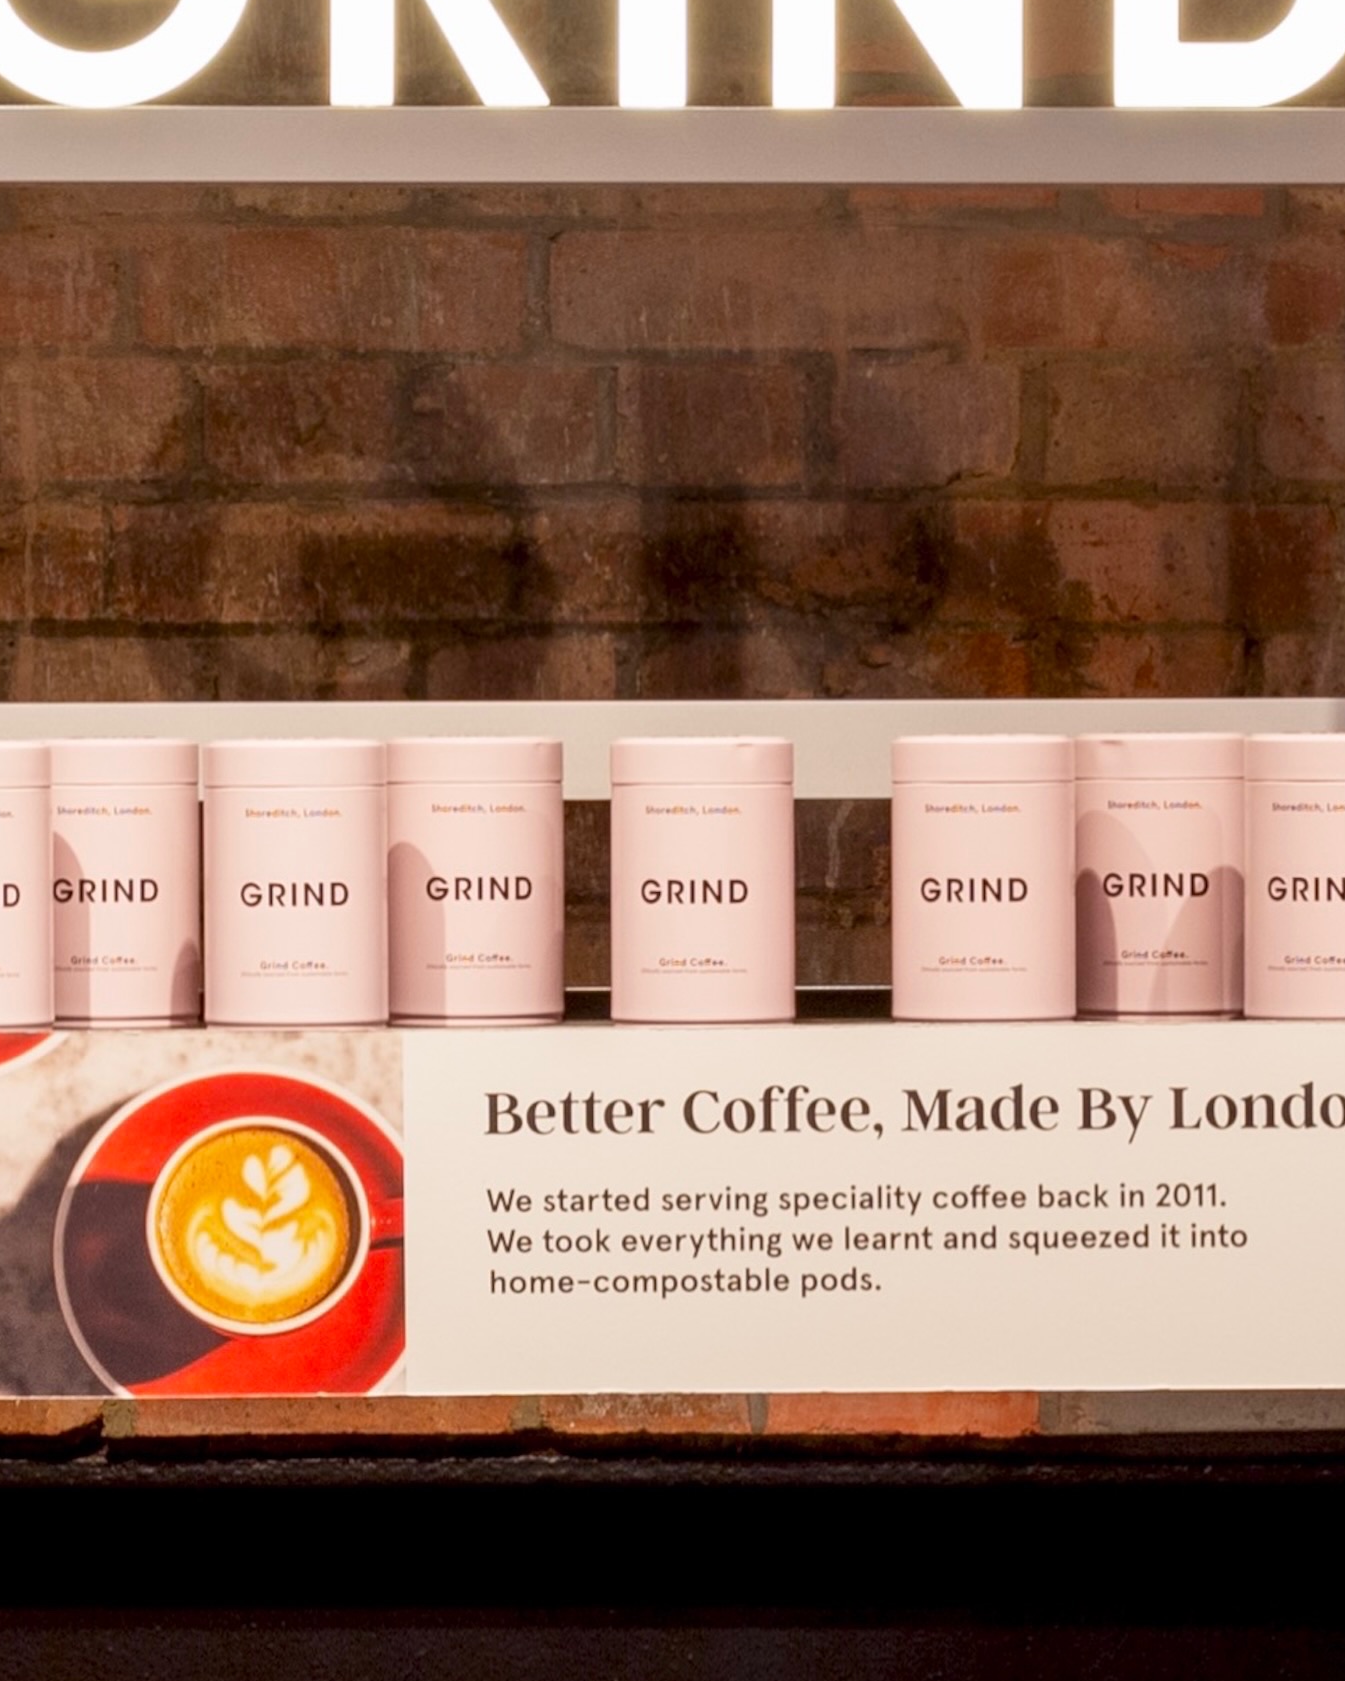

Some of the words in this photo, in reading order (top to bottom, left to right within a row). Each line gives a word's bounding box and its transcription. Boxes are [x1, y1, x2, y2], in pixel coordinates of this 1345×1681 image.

[240, 882, 349, 908] GRIND
[640, 878, 749, 905] GRIND
[1102, 872, 1209, 898] GRIND
[483, 1089, 666, 1136] Better
[683, 1085, 884, 1139] Coffee,
[900, 1082, 1059, 1133] Made
[1078, 1086, 1154, 1146] By
[486, 1188, 532, 1213] We
[543, 1187, 650, 1213] started
[661, 1185, 769, 1218] serving
[779, 1184, 922, 1217] speciality
[932, 1184, 1027, 1210] coffee
[1038, 1183, 1109, 1209] back
[1119, 1182, 1145, 1208] in
[1156, 1182, 1227, 1208] 2011.
[487, 1229, 533, 1254] We
[542, 1228, 611, 1254] took
[621, 1226, 783, 1259] everything
[791, 1232, 834, 1251] we
[844, 1226, 933, 1251] learnt
[943, 1225, 997, 1250] and
[1008, 1223, 1150, 1256] squeezed
[1161, 1223, 1180, 1249] it
[1191, 1222, 1248, 1248] into
[490, 1267, 790, 1300] home-compostable
[801, 1266, 882, 1299] pods.
